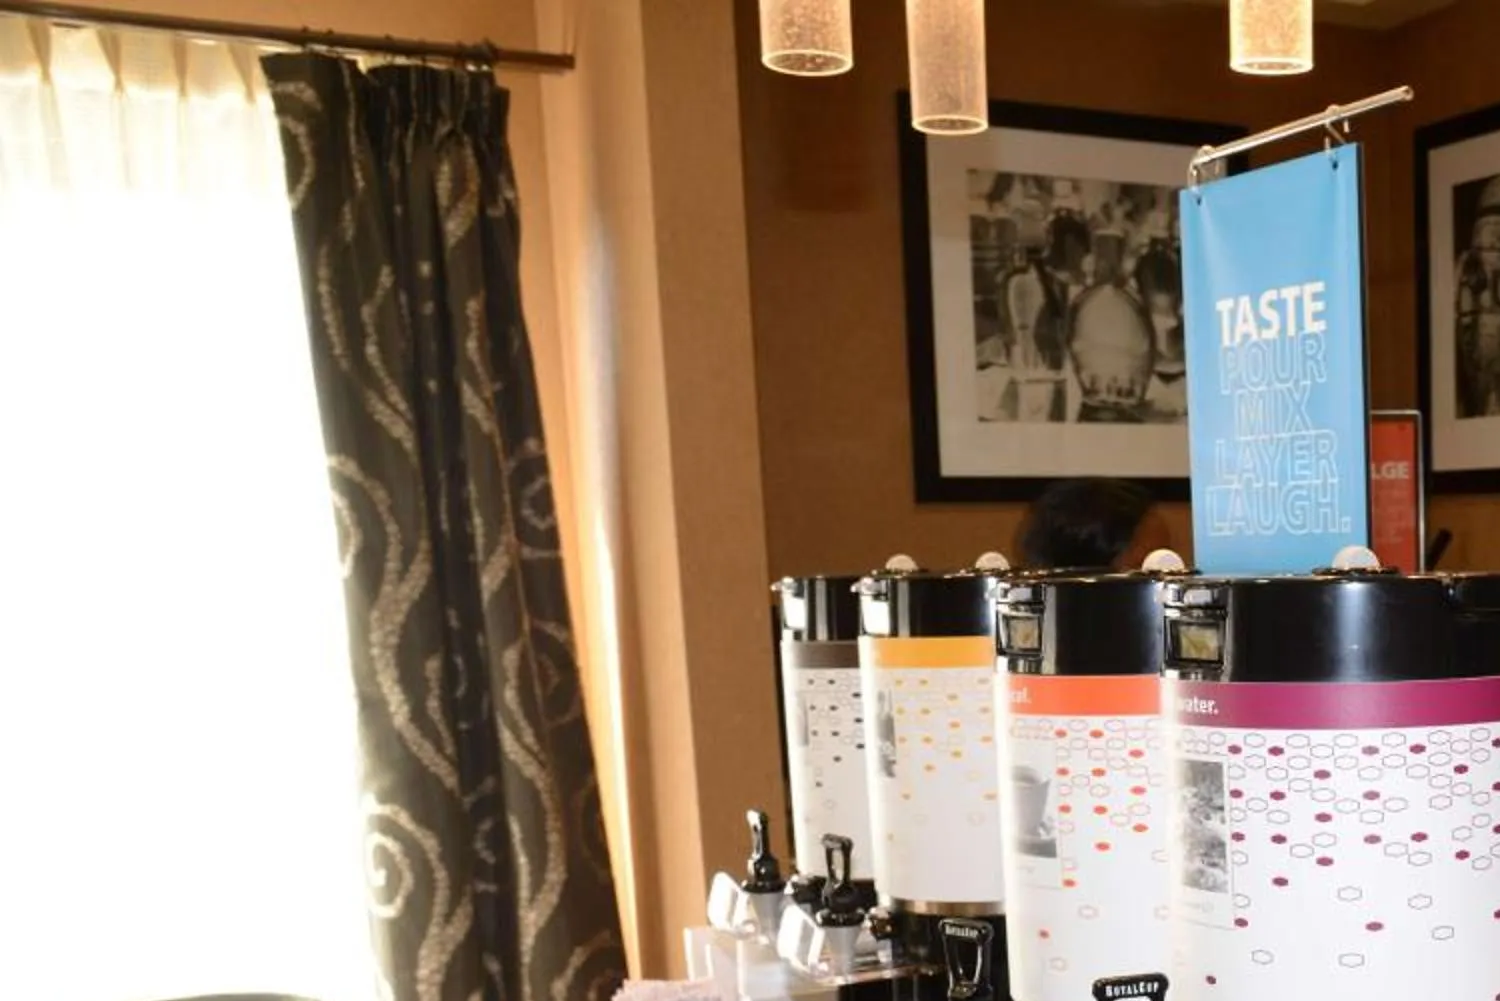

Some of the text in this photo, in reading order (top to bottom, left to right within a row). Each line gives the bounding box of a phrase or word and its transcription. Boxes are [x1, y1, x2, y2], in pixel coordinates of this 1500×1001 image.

[1215, 280, 1328, 348] TASTE
[1218, 330, 1328, 396] POUR
[1233, 380, 1313, 441] MIX
[1214, 429, 1339, 488] LAYER
[1205, 479, 1352, 537] LAUGH.
